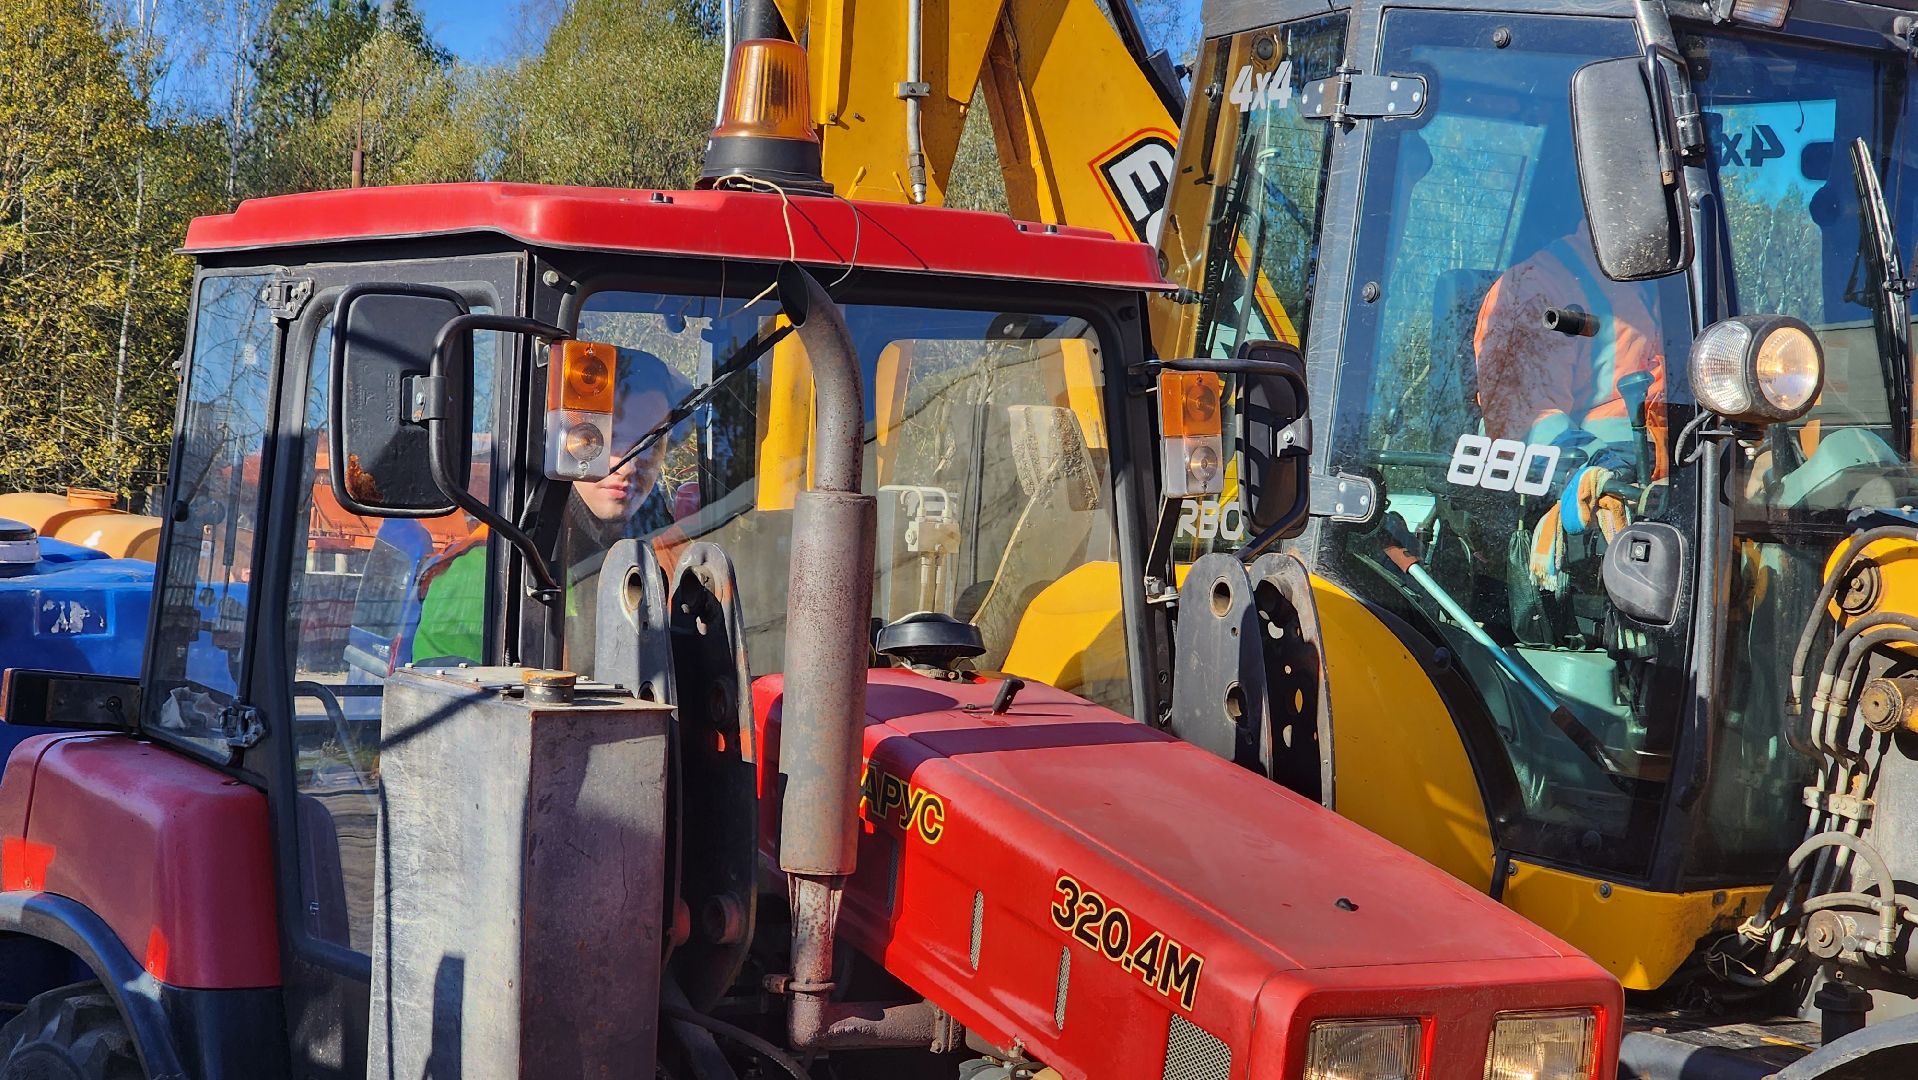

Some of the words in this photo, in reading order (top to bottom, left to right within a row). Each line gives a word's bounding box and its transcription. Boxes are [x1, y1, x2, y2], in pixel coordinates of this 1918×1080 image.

[1229, 60, 1293, 113] 4x4
[1446, 433, 1561, 497] 880
[1177, 499, 1244, 541] RBO
[860, 764, 945, 845] АРУС
[1051, 875, 1205, 1012] 320.4M
